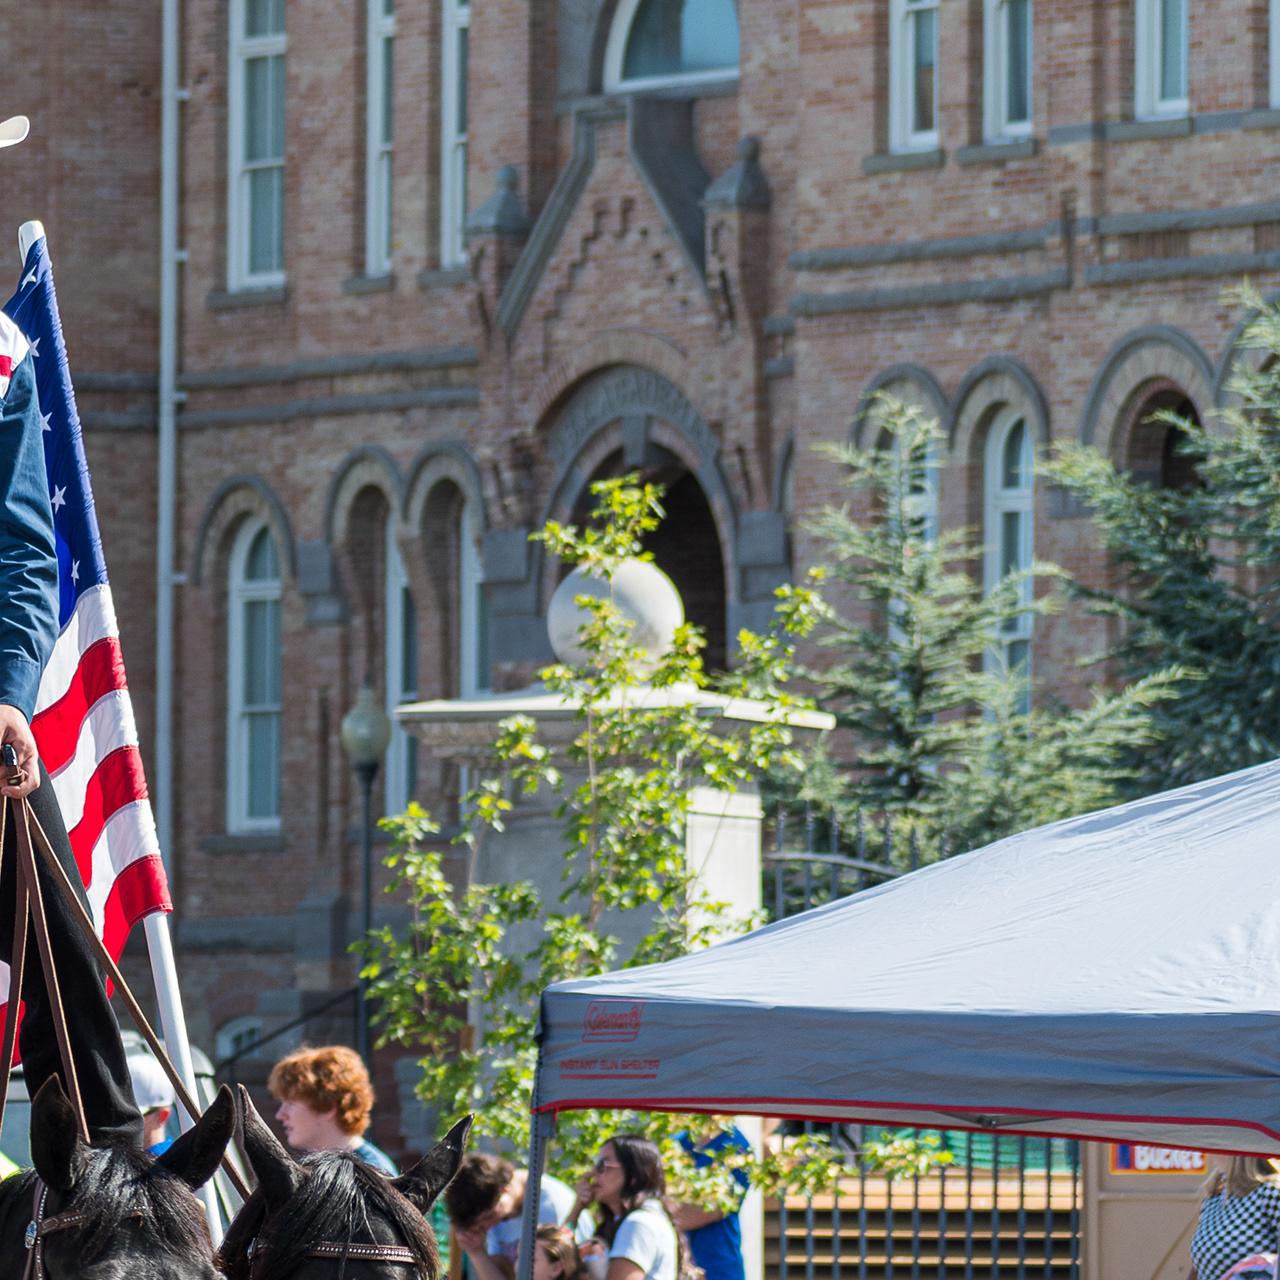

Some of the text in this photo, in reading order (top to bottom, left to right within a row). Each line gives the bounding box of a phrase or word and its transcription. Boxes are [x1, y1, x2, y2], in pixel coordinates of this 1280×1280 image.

[588, 1005, 630, 1031] Coleman
[560, 1059, 660, 1071] INSTANT SUN SHELTER
